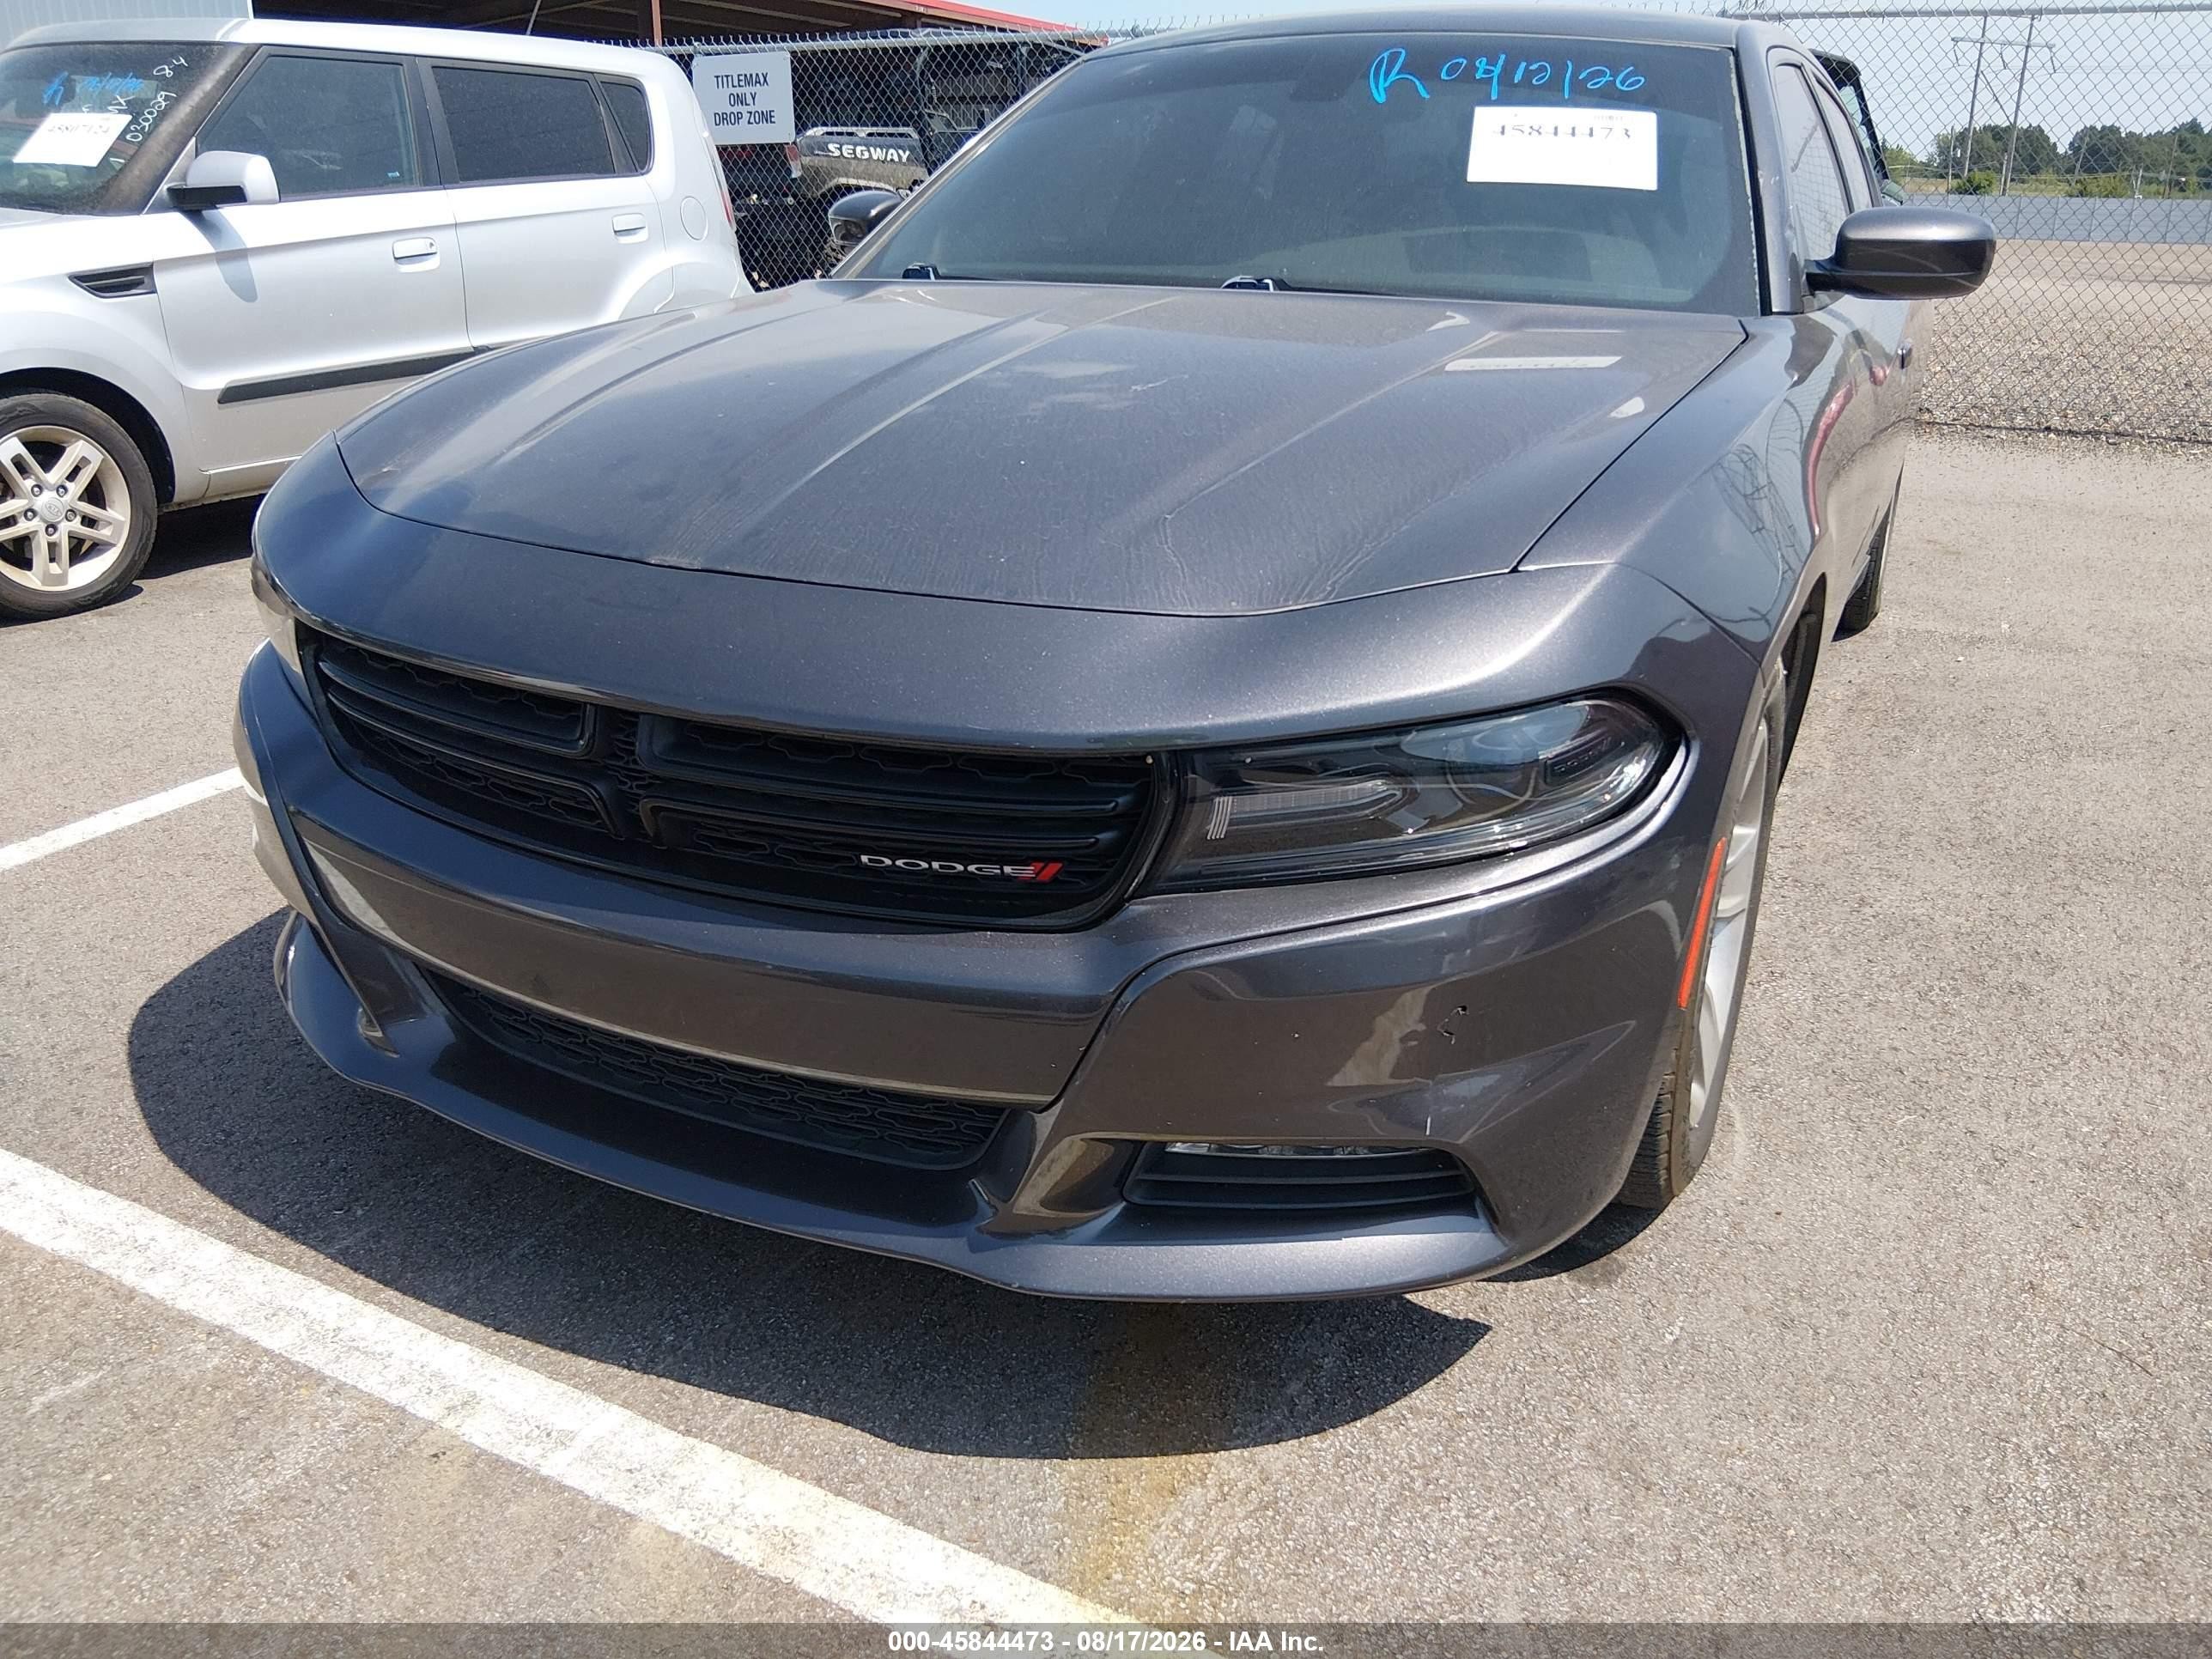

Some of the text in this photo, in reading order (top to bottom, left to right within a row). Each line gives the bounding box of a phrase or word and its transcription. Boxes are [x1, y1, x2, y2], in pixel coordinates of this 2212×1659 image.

[714, 72, 769, 89] TITLEMAX
[728, 92, 757, 107] ONLY
[714, 109, 776, 126] DROP ZONE
[827, 143, 910, 163] SEGWAY
[860, 854, 1036, 878] DODGE
